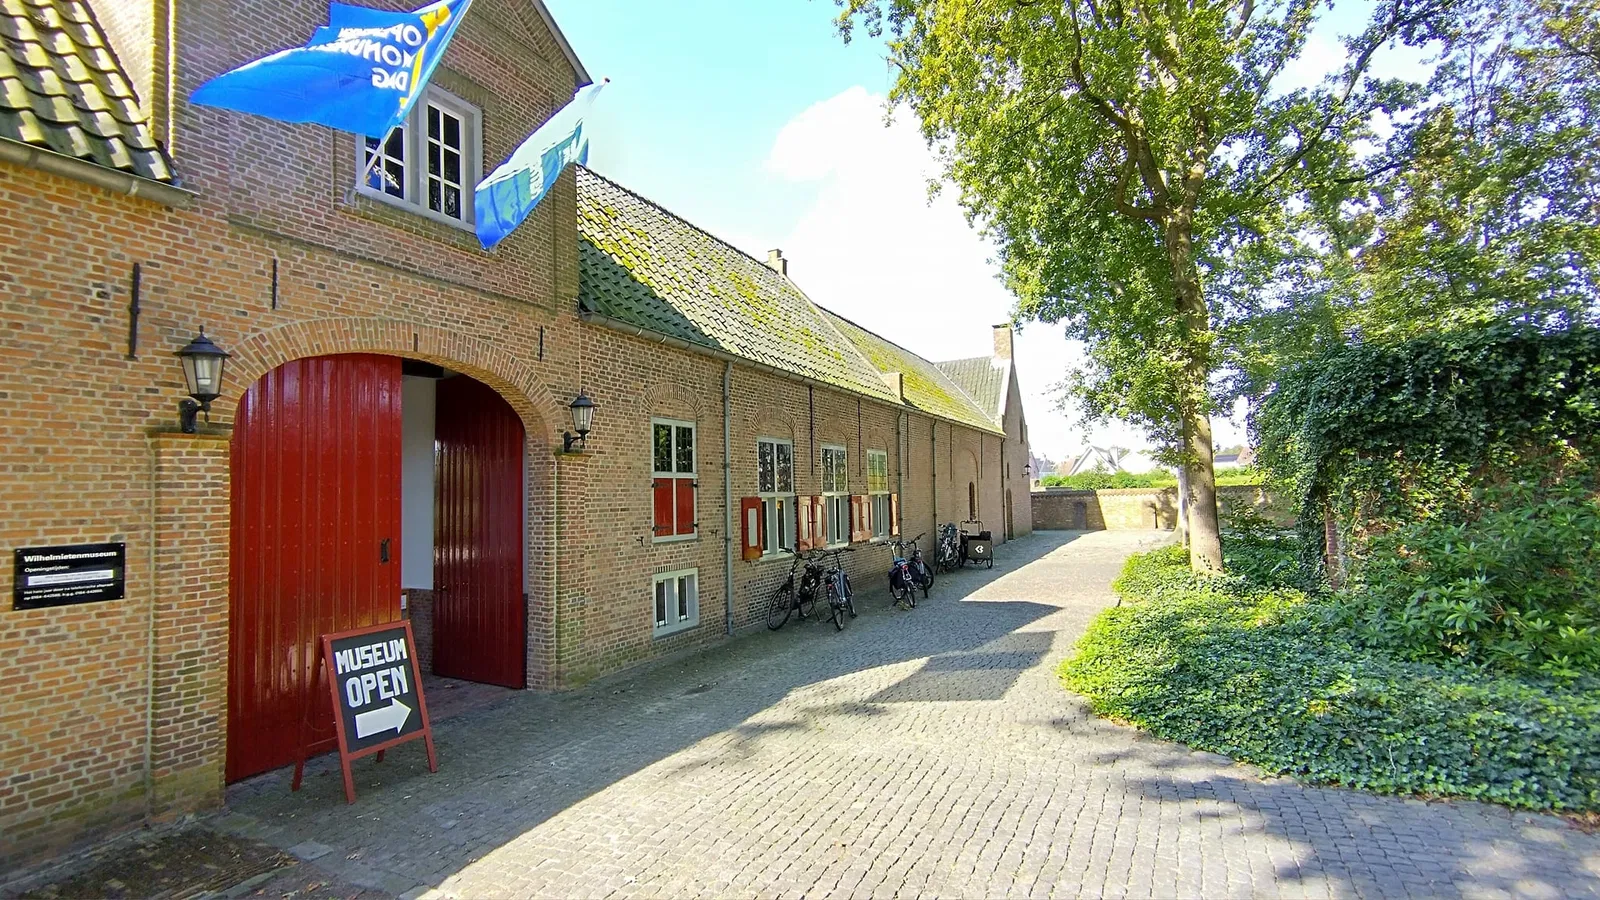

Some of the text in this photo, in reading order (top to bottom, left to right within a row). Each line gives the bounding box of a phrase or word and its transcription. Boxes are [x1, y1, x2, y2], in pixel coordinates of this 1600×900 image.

[24, 551, 117, 563] Wilhelmietenmuseum
[334, 638, 408, 675] MUSEUM
[345, 665, 409, 708] OPEN
